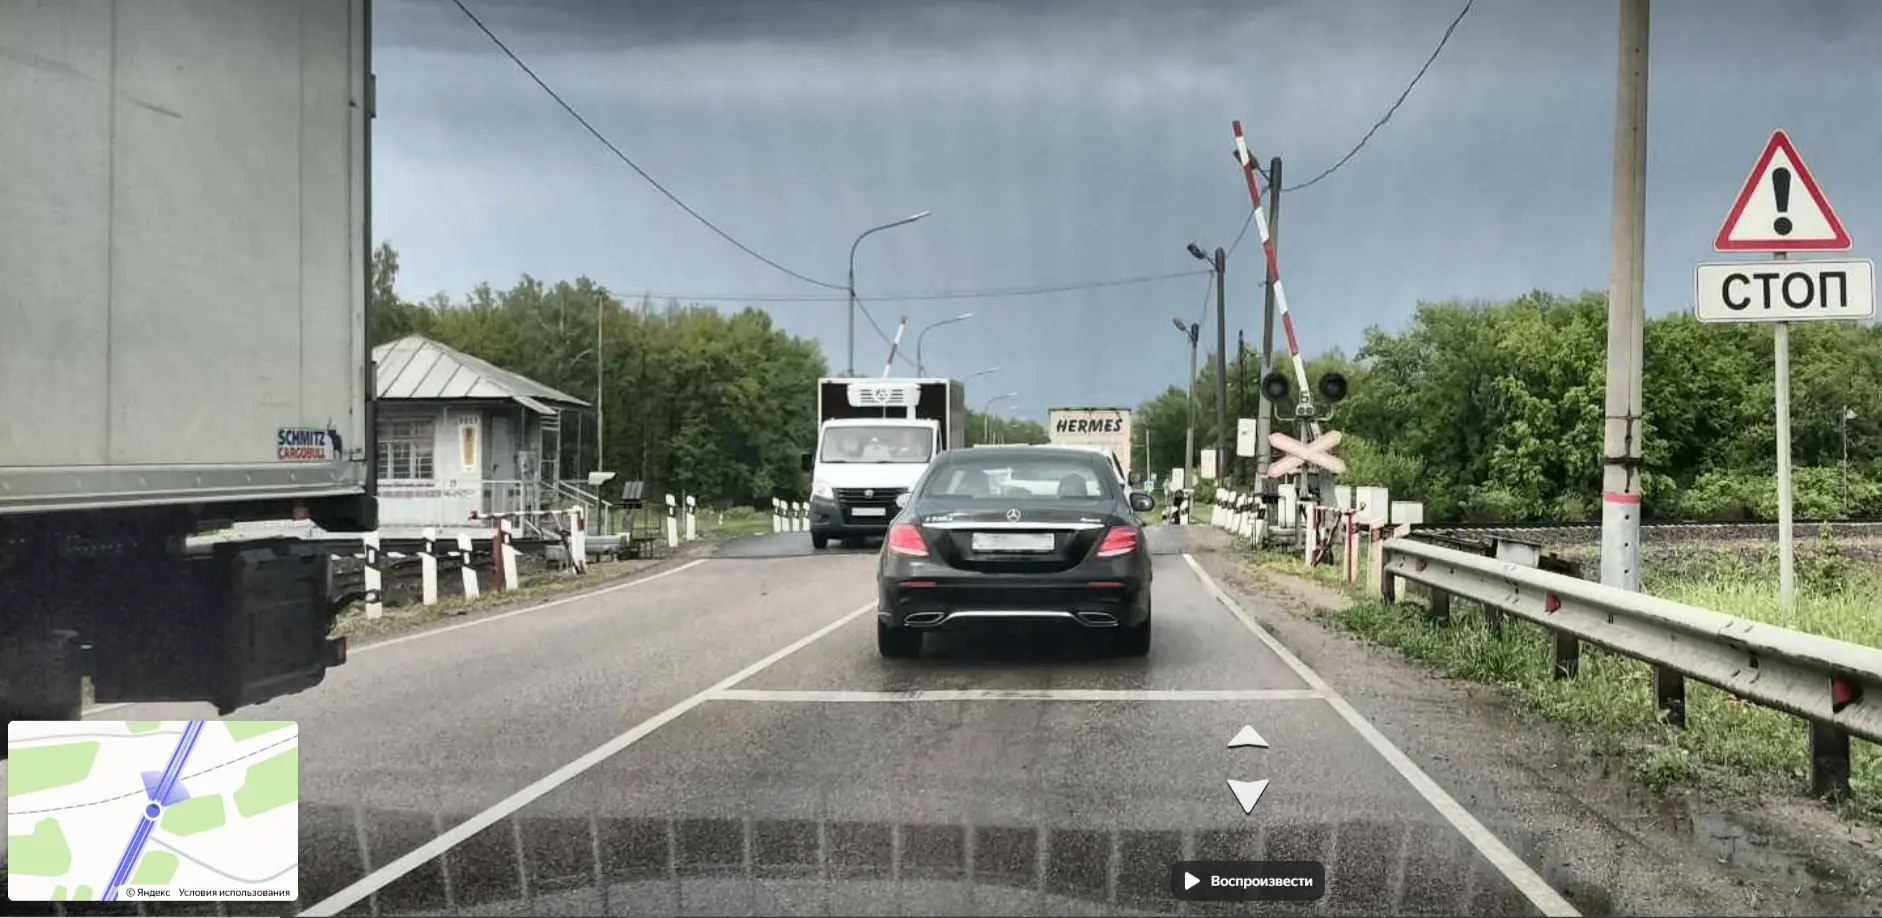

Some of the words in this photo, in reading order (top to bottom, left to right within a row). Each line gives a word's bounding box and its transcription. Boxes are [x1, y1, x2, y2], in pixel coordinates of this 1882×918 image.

[1722, 271, 1848, 311] СТОП
[1056, 418, 1123, 433] HERMES
[278, 429, 326, 446] SCHMITZ
[278, 447, 326, 459] CARGOBULL
